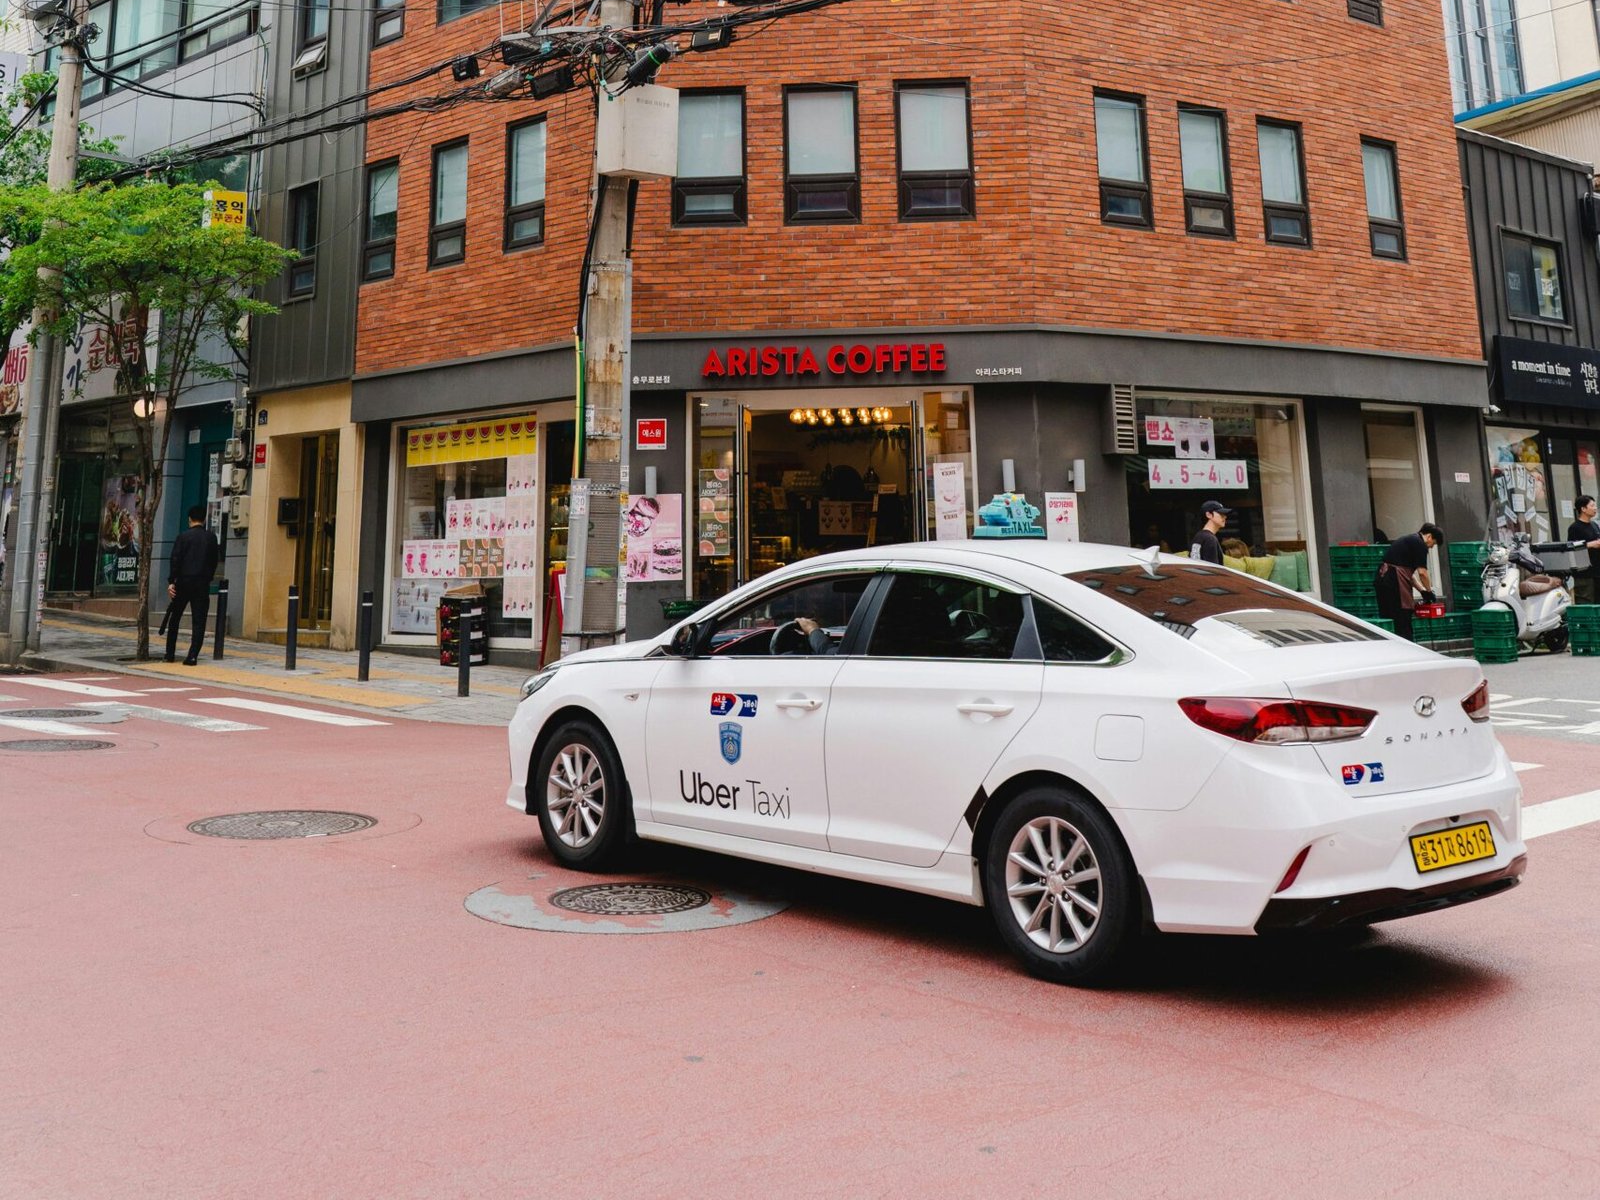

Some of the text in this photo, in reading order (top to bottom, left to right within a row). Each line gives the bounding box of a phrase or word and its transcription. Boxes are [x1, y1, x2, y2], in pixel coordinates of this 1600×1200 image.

[216, 200, 243, 214] 홍익
[702, 343, 947, 377] ARISTA COFFEE
[975, 367, 1022, 376] 아리스타커피
[1511, 360, 1571, 377] a moment in time
[1012, 522, 1031, 534] TAXI
[714, 695, 728, 710] 서울
[1385, 727, 1468, 744] SONATA
[680, 769, 791, 820] Uber Taxi
